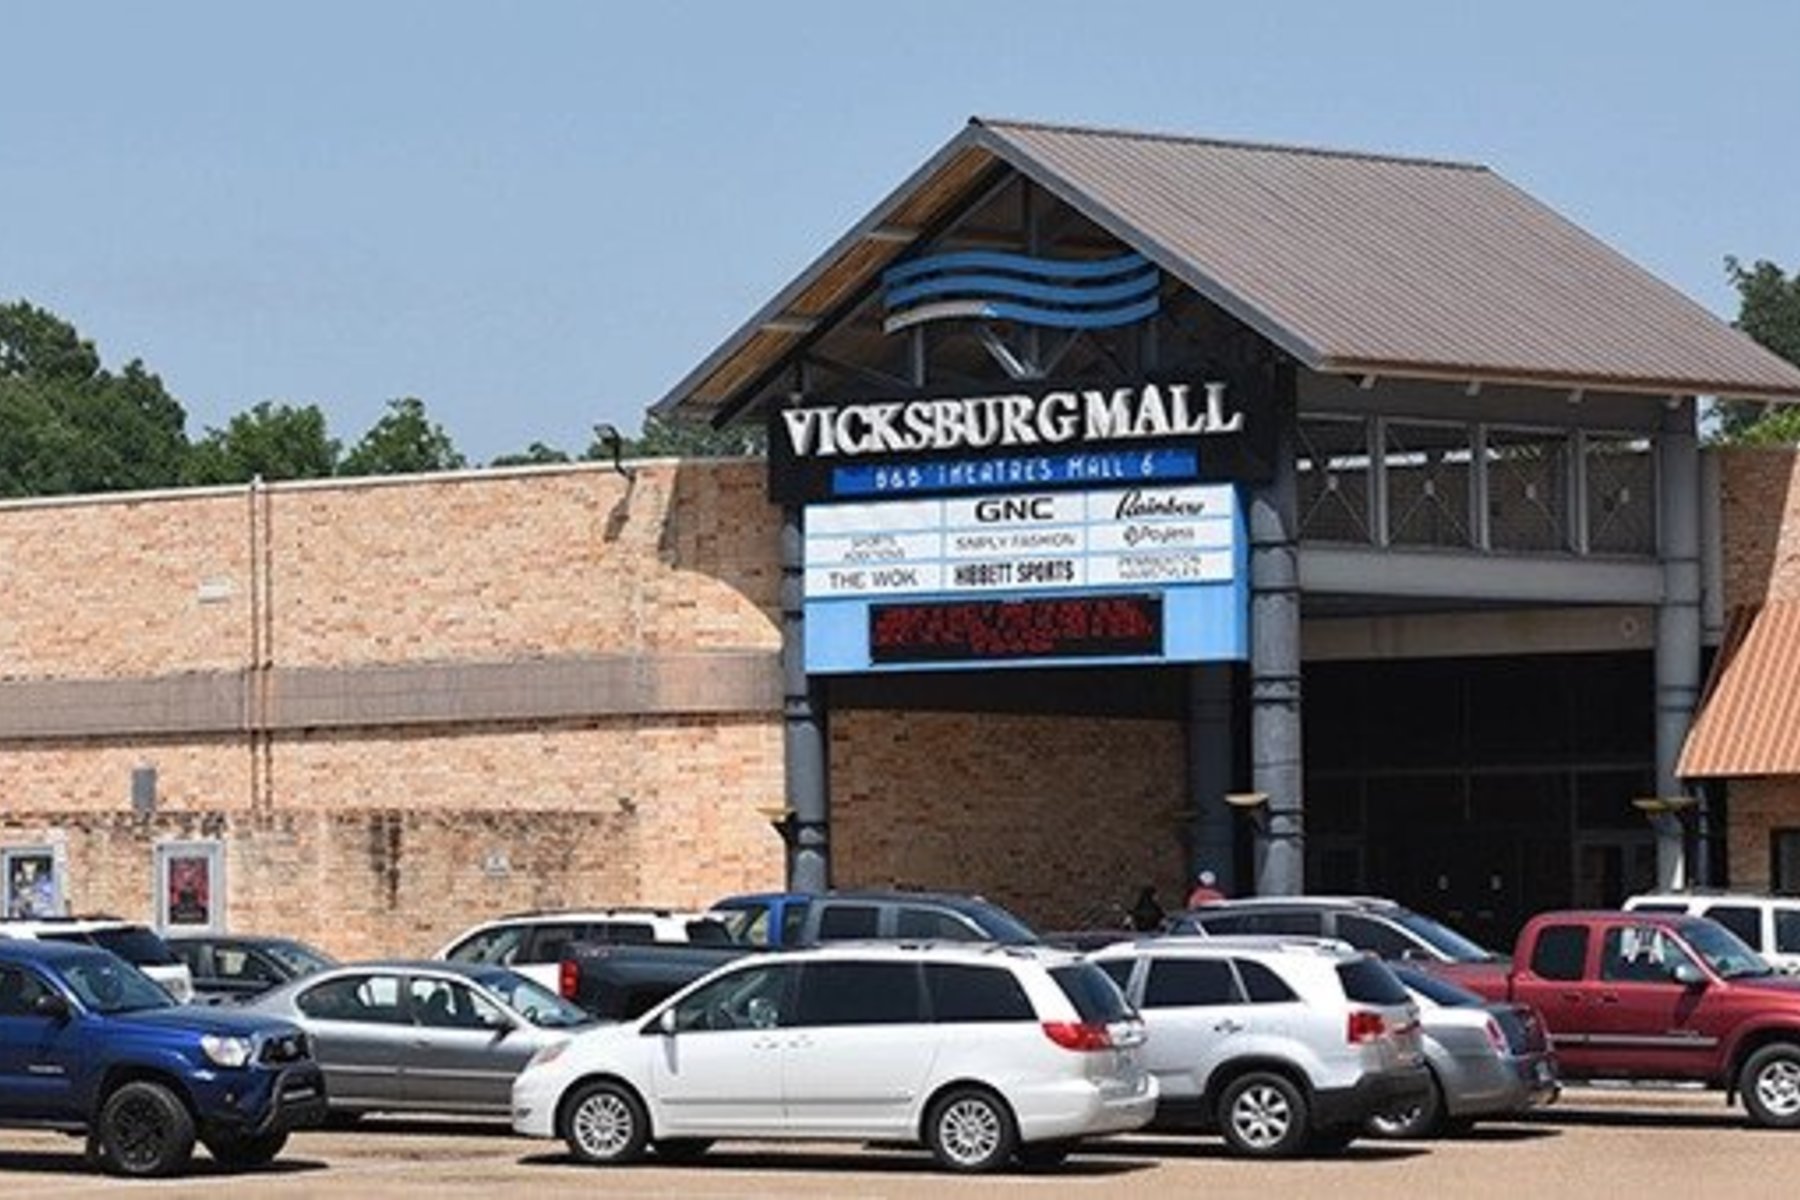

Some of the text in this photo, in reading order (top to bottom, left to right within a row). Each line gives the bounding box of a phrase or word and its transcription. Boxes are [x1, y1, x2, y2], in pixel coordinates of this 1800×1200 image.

[781, 383, 1243, 457] VICKSBURG MALL
[936, 457, 1053, 485] THEATRES
[1066, 453, 1125, 478] MALL
[1140, 453, 1154, 476] 6
[975, 497, 1054, 522] GNC
[1115, 486, 1205, 520] Rainbow
[829, 567, 919, 589] THE WOK
[954, 560, 1075, 586] HIBBETT SPORTS
